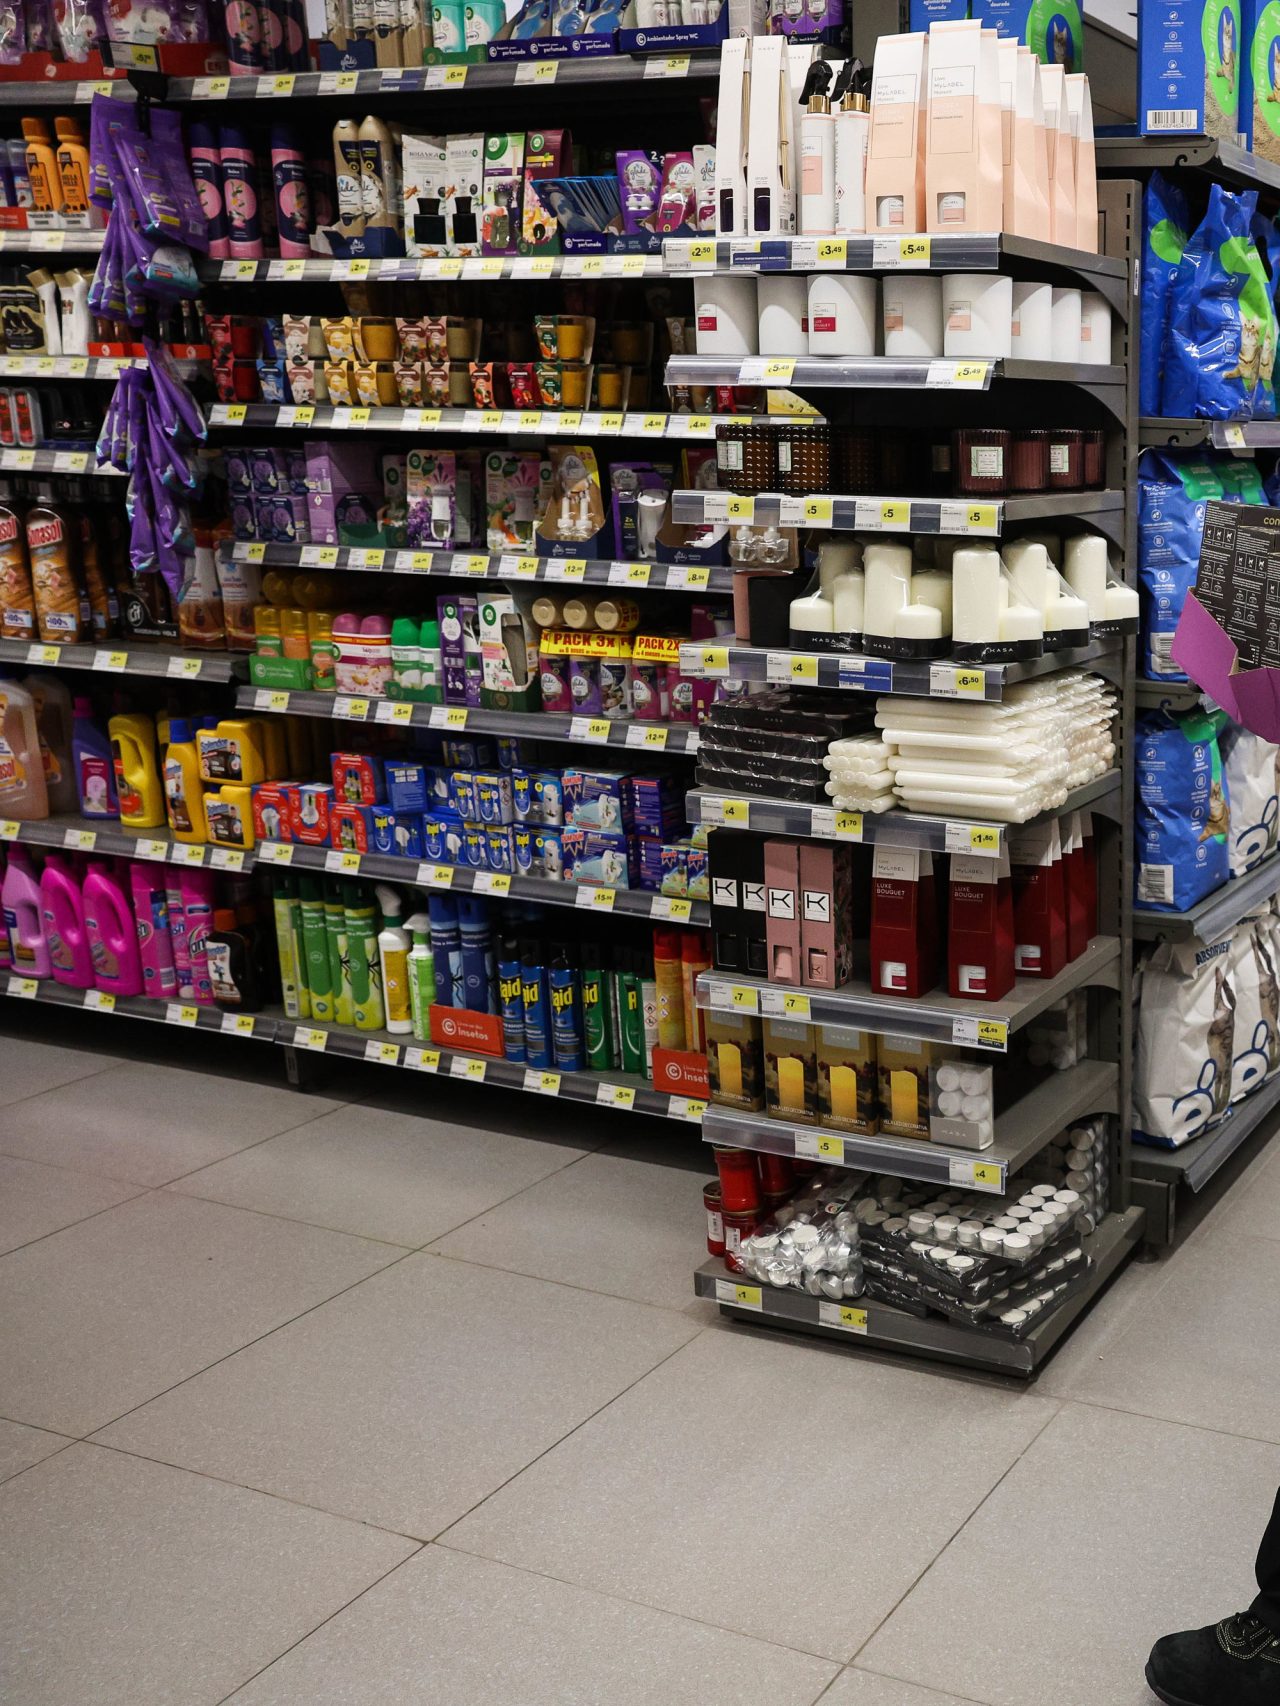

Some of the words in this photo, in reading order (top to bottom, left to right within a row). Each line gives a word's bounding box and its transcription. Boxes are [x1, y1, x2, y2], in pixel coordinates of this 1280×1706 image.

[691, 247, 711, 257] €2,50
[821, 245, 842, 256] €3,49
[903, 245, 925, 256] €5,49
[957, 366, 981, 377] €5,49
[730, 502, 740, 513] €5
[807, 504, 817, 515] €5
[884, 507, 894, 518] €5
[970, 511, 980, 522] €5
[553, 633, 593, 647] PACK
[638, 638, 664, 650] PACK
[704, 653, 714, 665] €4
[793, 662, 803, 673] €4
[958, 675, 979, 687] €6,50
[725, 806, 735, 816] €4
[836, 819, 858, 831] €1,70
[876, 888, 906, 896] BOUQUET
[734, 992, 744, 1002] €7
[786, 998, 796, 1009] €7
[458, 1024, 489, 1041] Insetos
[684, 1072, 709, 1084] Inset
[820, 1142, 830, 1153] €5
[975, 1169, 986, 1180] €4
